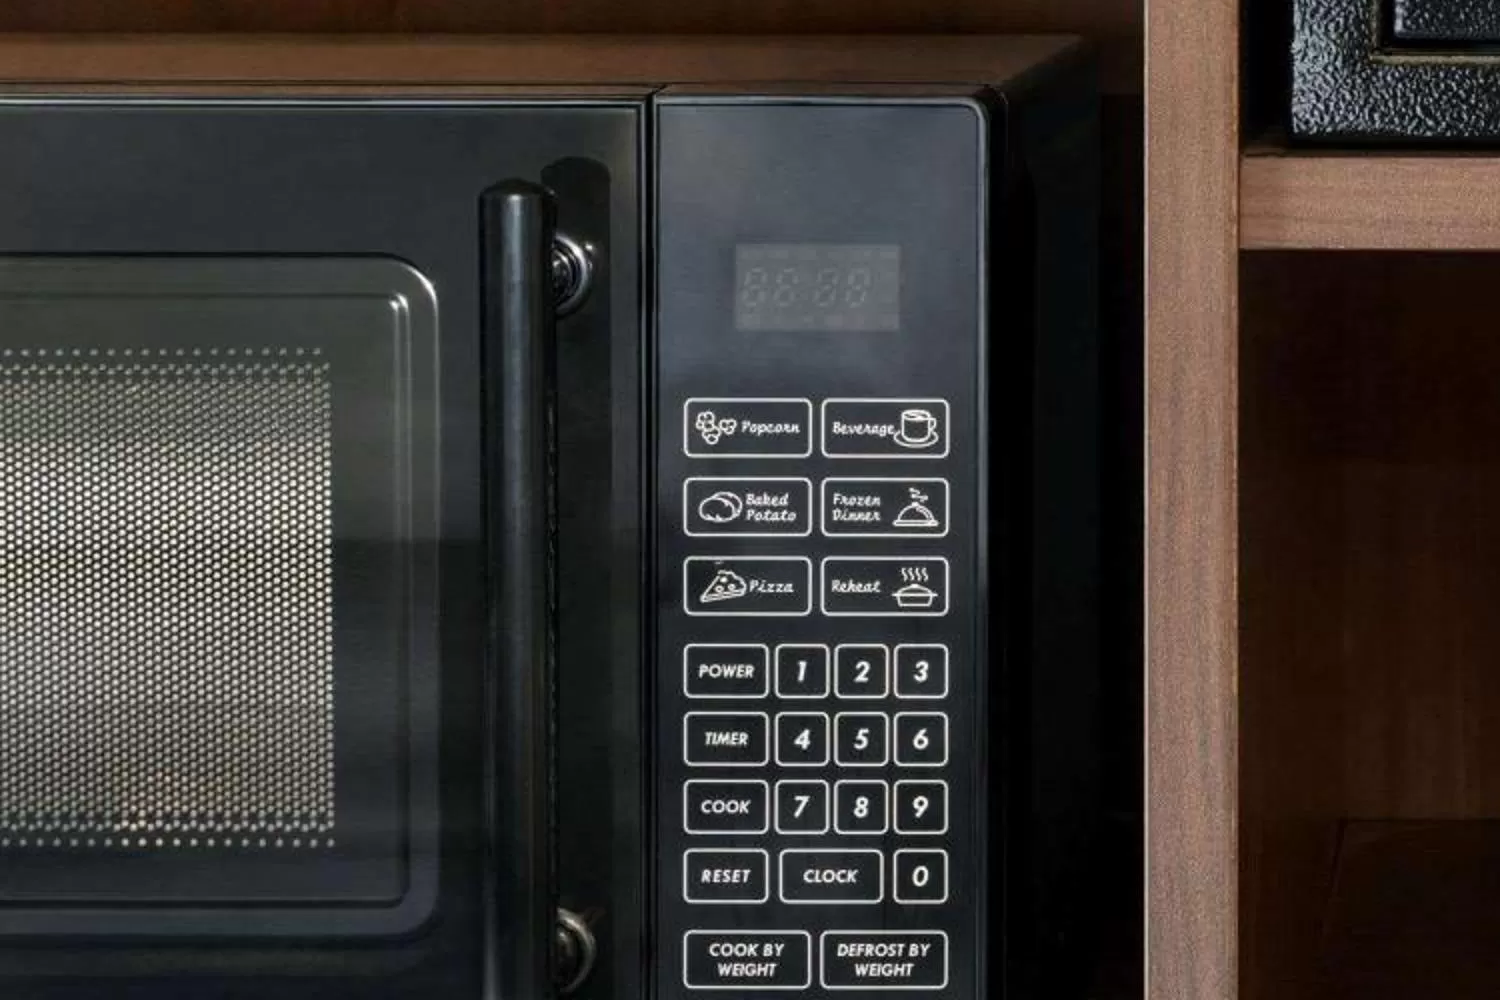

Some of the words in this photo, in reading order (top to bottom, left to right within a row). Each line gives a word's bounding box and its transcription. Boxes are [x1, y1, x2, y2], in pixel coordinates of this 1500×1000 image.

[741, 420, 801, 437] Popcorn
[832, 421, 896, 440] Beverage
[745, 492, 789, 508] Baked
[832, 492, 881, 507] Frozen
[746, 508, 797, 522] Potato
[831, 508, 881, 522] Dinner
[749, 579, 795, 593] Pizza
[831, 579, 881, 593] Reheat
[698, 663, 755, 679] POWER
[797, 660, 807, 682] 1
[854, 660, 871, 683] 2
[913, 660, 929, 683] 3
[705, 731, 749, 746] TIMER
[794, 728, 811, 750] 4
[853, 727, 870, 750] 5
[912, 728, 929, 750] 6
[700, 799, 751, 814] COOK
[793, 795, 810, 819] 7
[853, 796, 869, 819] 8
[912, 795, 929, 818] 9
[701, 868, 751, 883] RESET
[802, 868, 859, 884] CLOCK
[912, 865, 929, 887] 0
[708, 942, 760, 958] COOK
[762, 943, 785, 957] BY
[836, 943, 906, 957] DEFROST
[908, 943, 931, 957] BY
[717, 962, 778, 977] WEIGHT
[854, 962, 915, 977] WEIGHT
